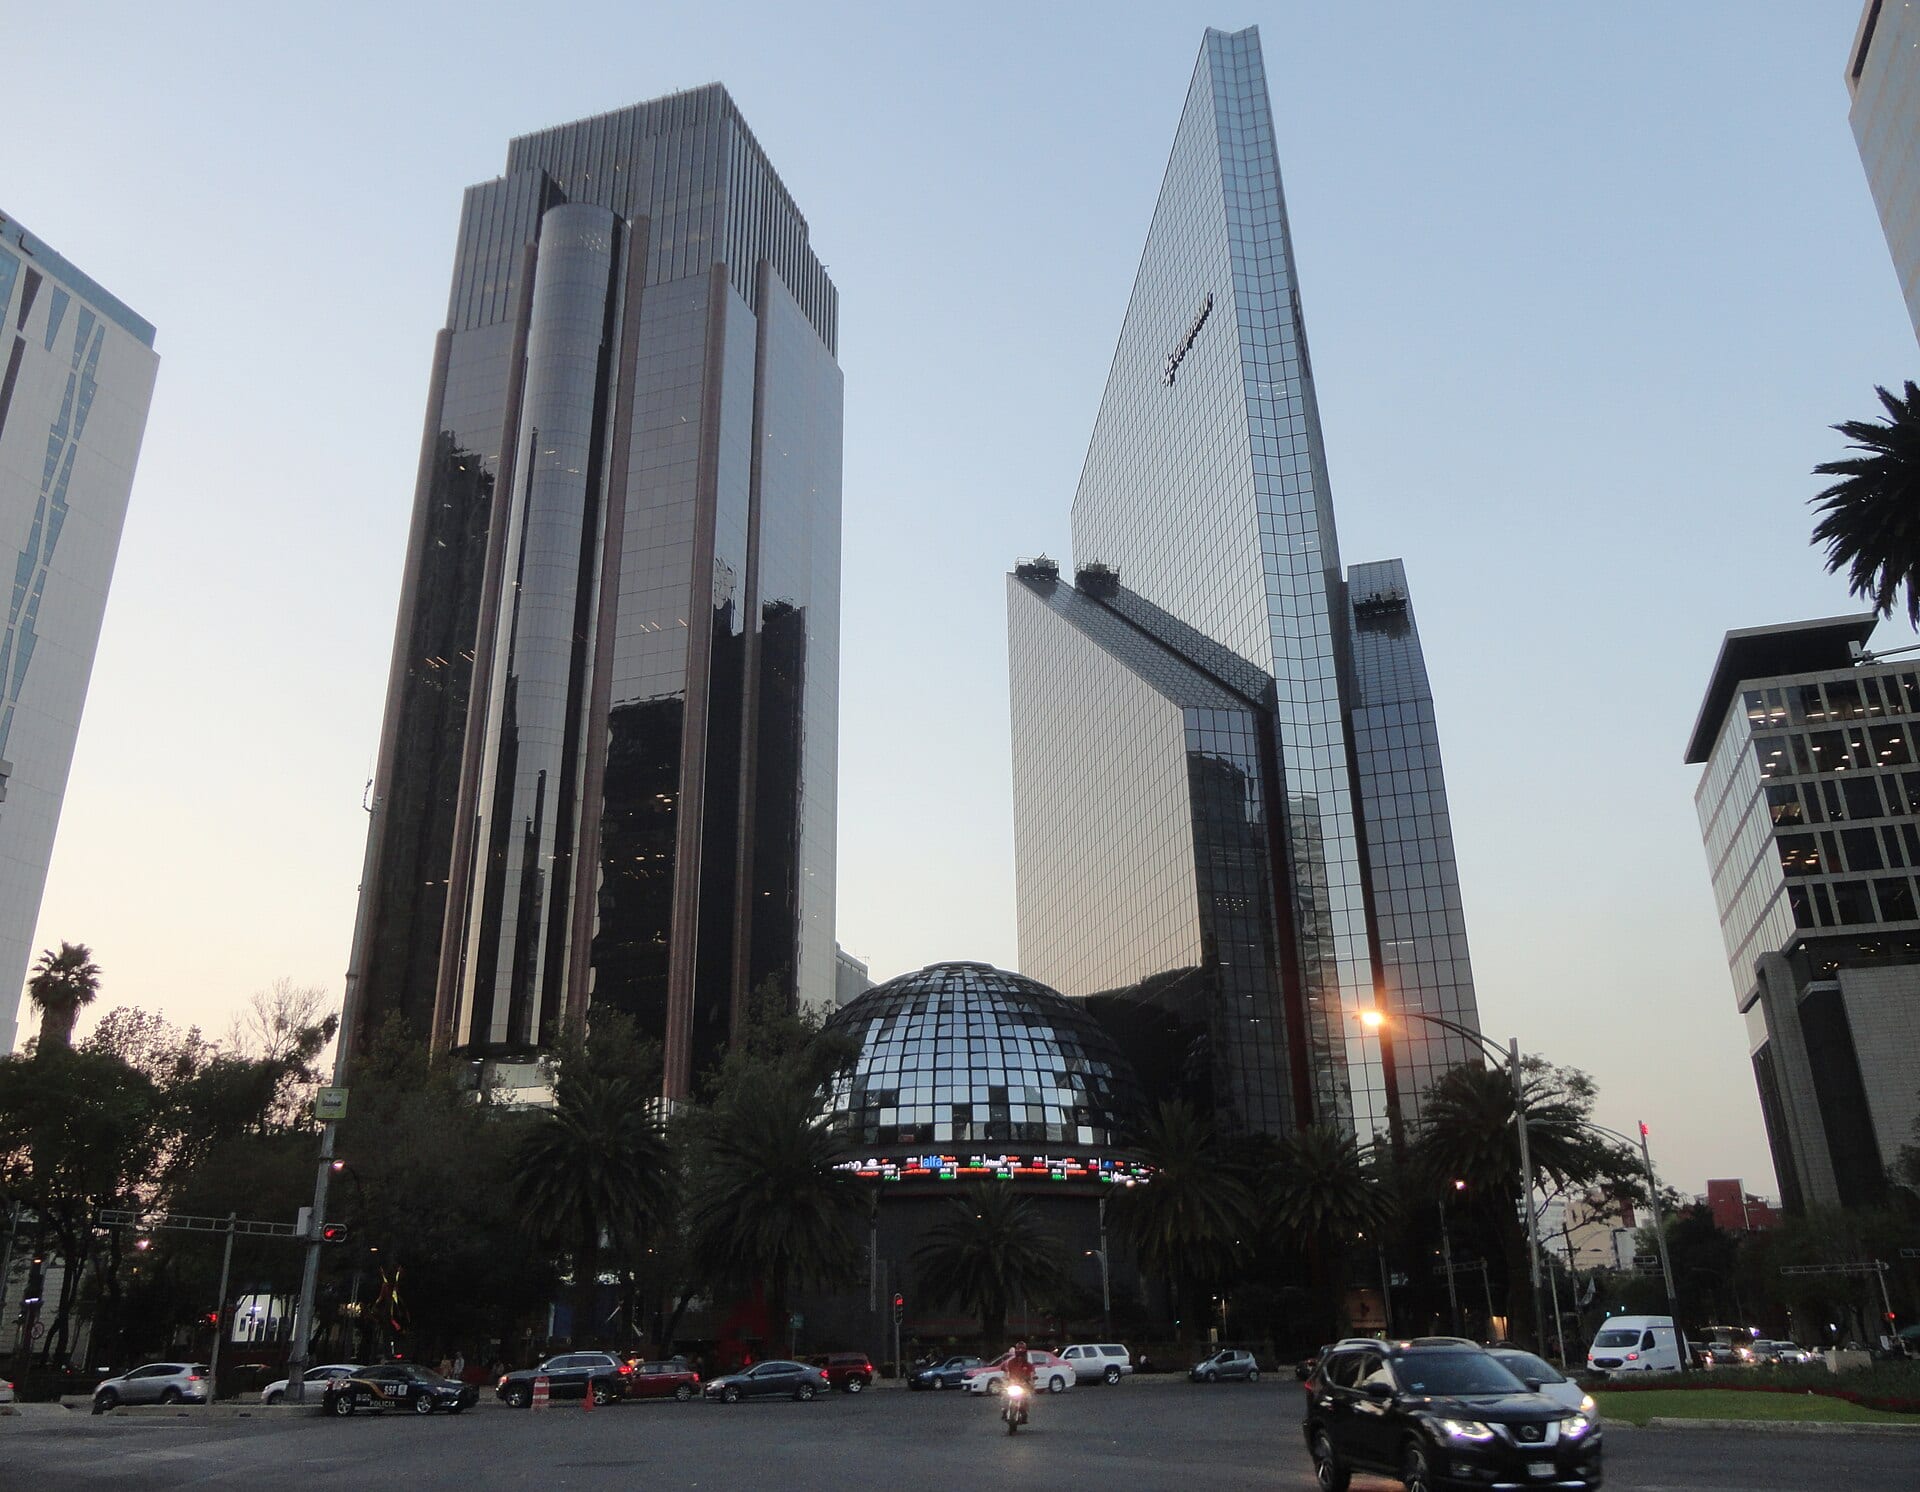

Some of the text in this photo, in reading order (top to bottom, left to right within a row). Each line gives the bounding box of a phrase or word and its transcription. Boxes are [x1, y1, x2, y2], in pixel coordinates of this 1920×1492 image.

[923, 1155, 943, 1167] alfa
[384, 1385, 397, 1396] SSP
[370, 1400, 396, 1408] POLICIA
